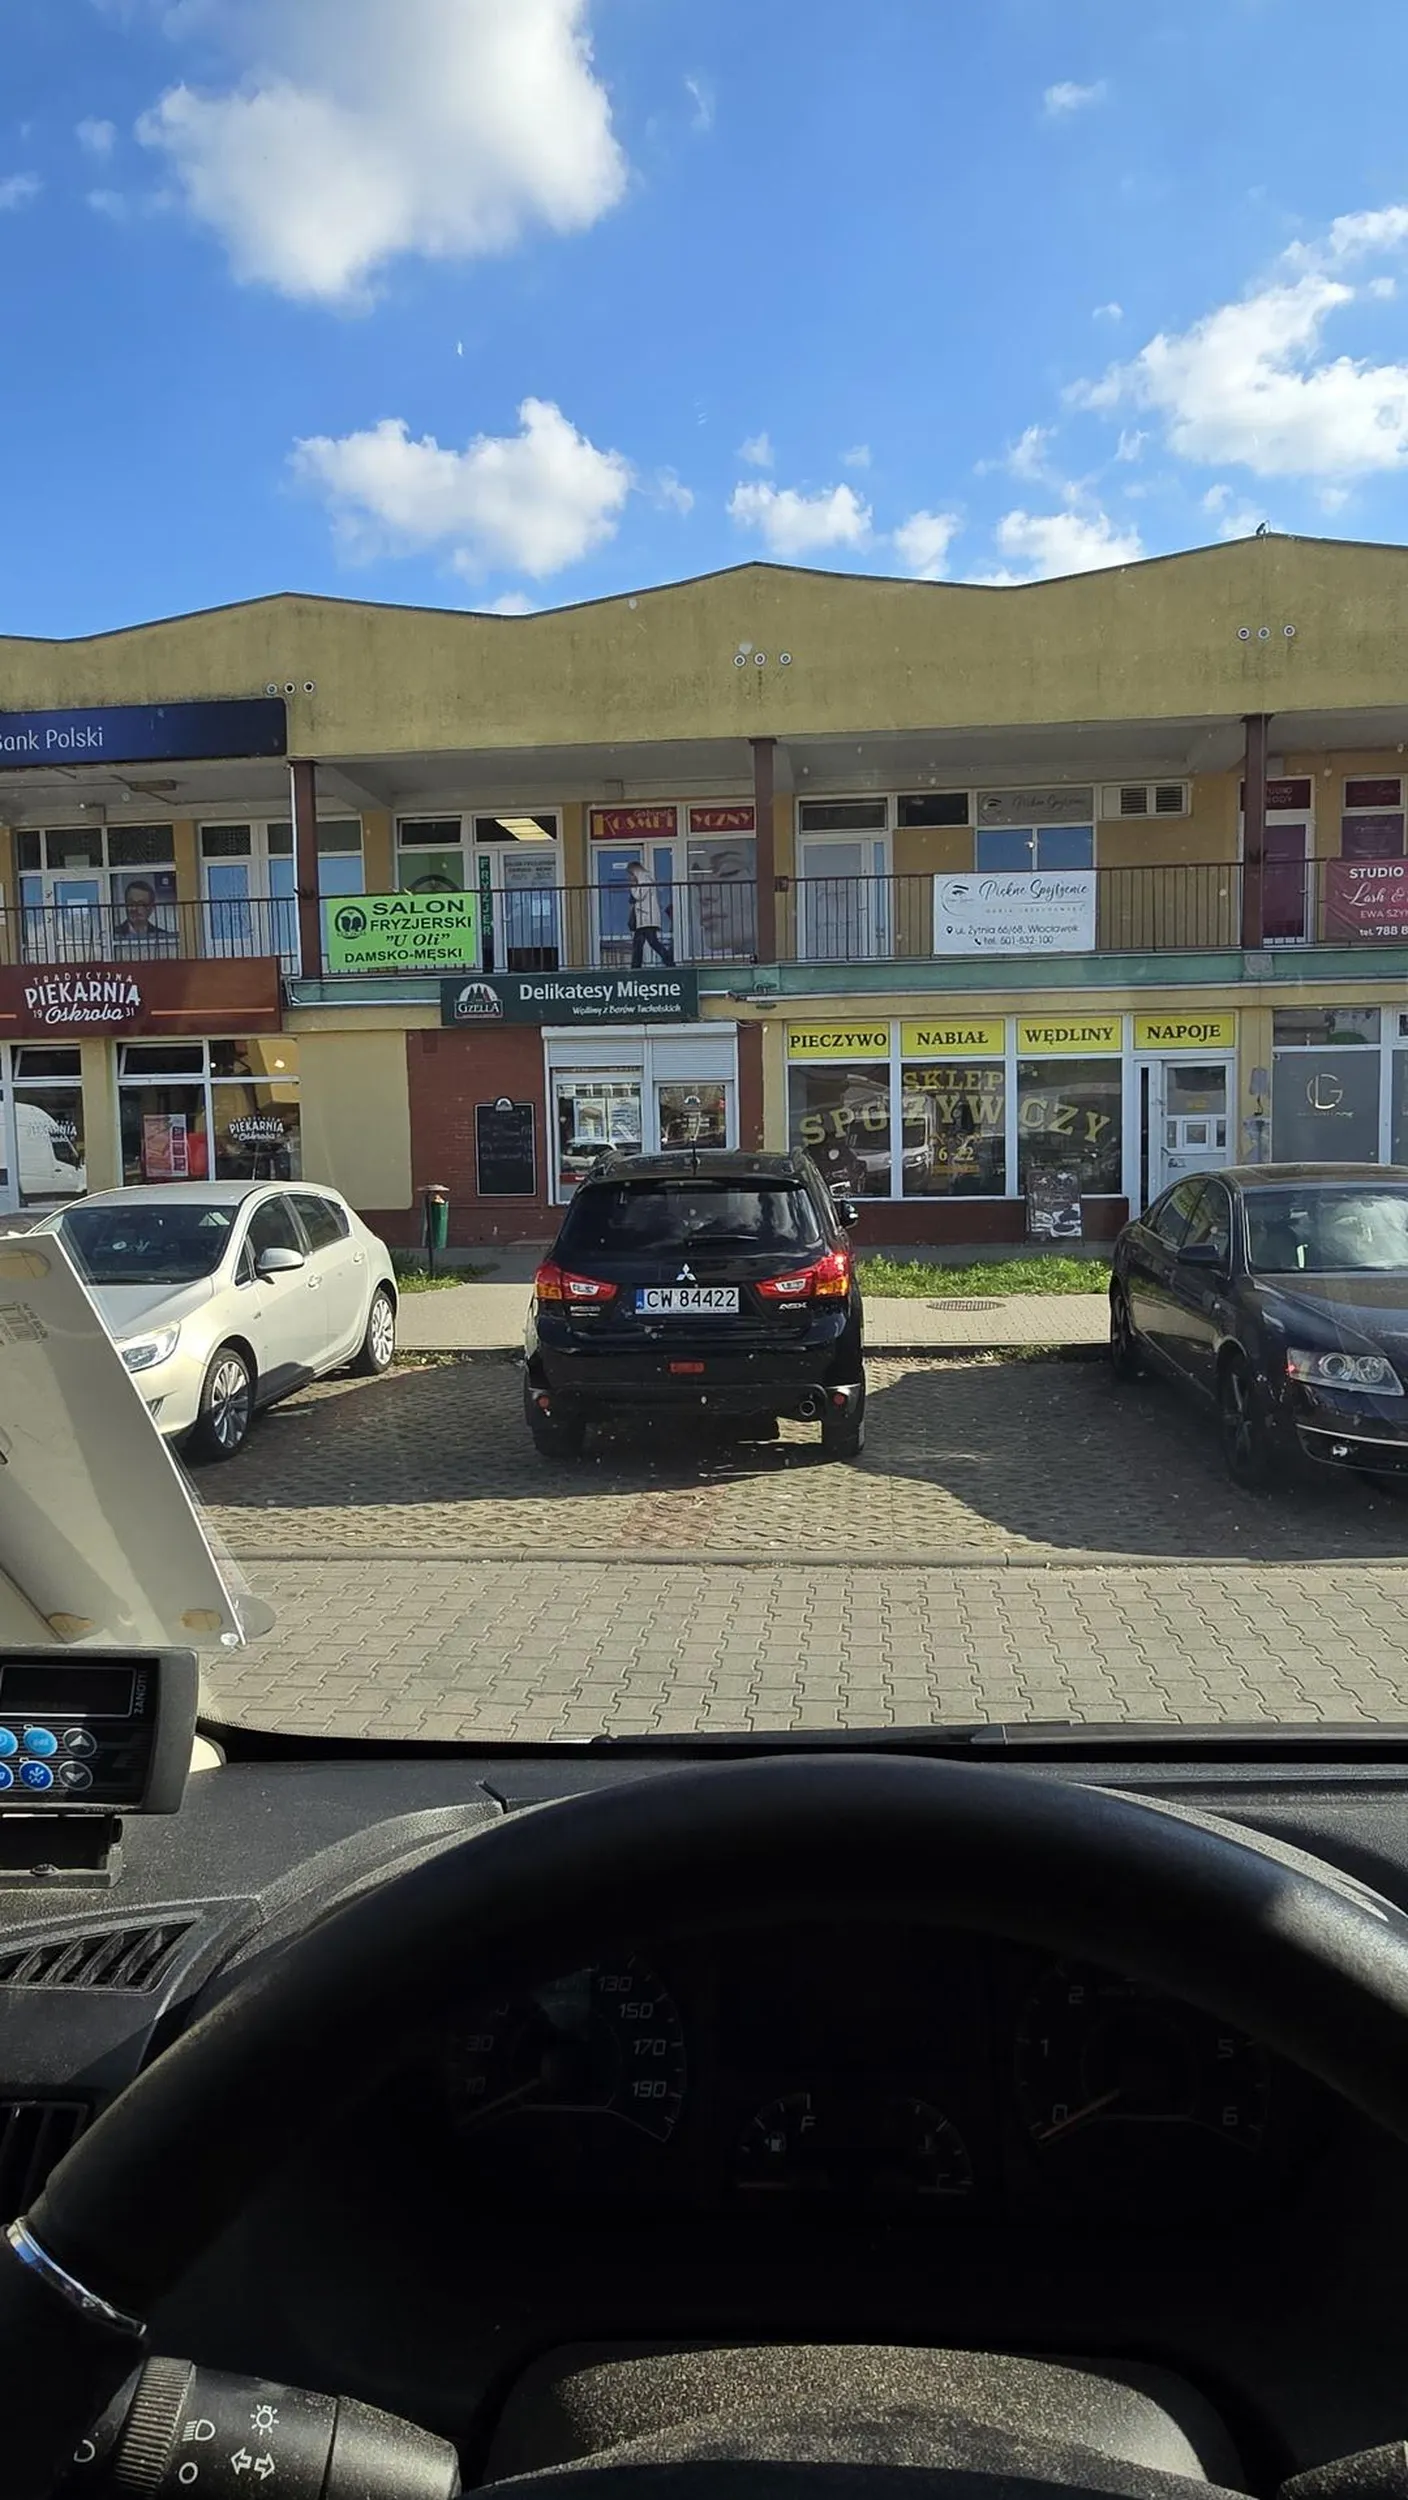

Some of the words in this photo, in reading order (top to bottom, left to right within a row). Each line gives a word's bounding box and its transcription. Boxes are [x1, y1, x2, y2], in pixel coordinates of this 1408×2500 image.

[46, 726, 104, 749] Polski
[1349, 866, 1404, 879] STUDIO
[372, 899, 465, 916] SALON
[1360, 910, 1384, 918] EWA
[370, 916, 472, 931] FRYZJERSKI
[1376, 926, 1398, 935] 788
[344, 948, 463, 963] DAMSKO-MĘSKI
[34, 972, 133, 985] TRADYCYJNA
[24, 981, 141, 1009] PIEKARNIA
[519, 983, 614, 1001] Delikatesy
[617, 980, 681, 1000] Mięsne
[33, 1009, 43, 1019] 19
[45, 1003, 125, 1024] Oskroba
[125, 1007, 135, 1017] 31
[790, 1032, 887, 1049] PIECZYWO
[917, 1030, 989, 1046] NABIAŁ
[1025, 1027, 1114, 1045] WĘDLINY
[1147, 1024, 1221, 1042] NAPOJE
[903, 1069, 1005, 1091] SKLEP
[228, 1120, 285, 1134] PIEKARNIA
[647, 1290, 673, 1307] CW
[679, 1289, 736, 1307] 84422
[597, 1975, 635, 1993] 130
[1067, 1984, 1085, 2005] 2
[618, 2003, 655, 2020] 150
[632, 2038, 668, 2057] 170
[1040, 2038, 1051, 2058] 1
[631, 2080, 668, 2099] 190
[800, 2114, 819, 2134] F
[1222, 2105, 1239, 2127] 6
